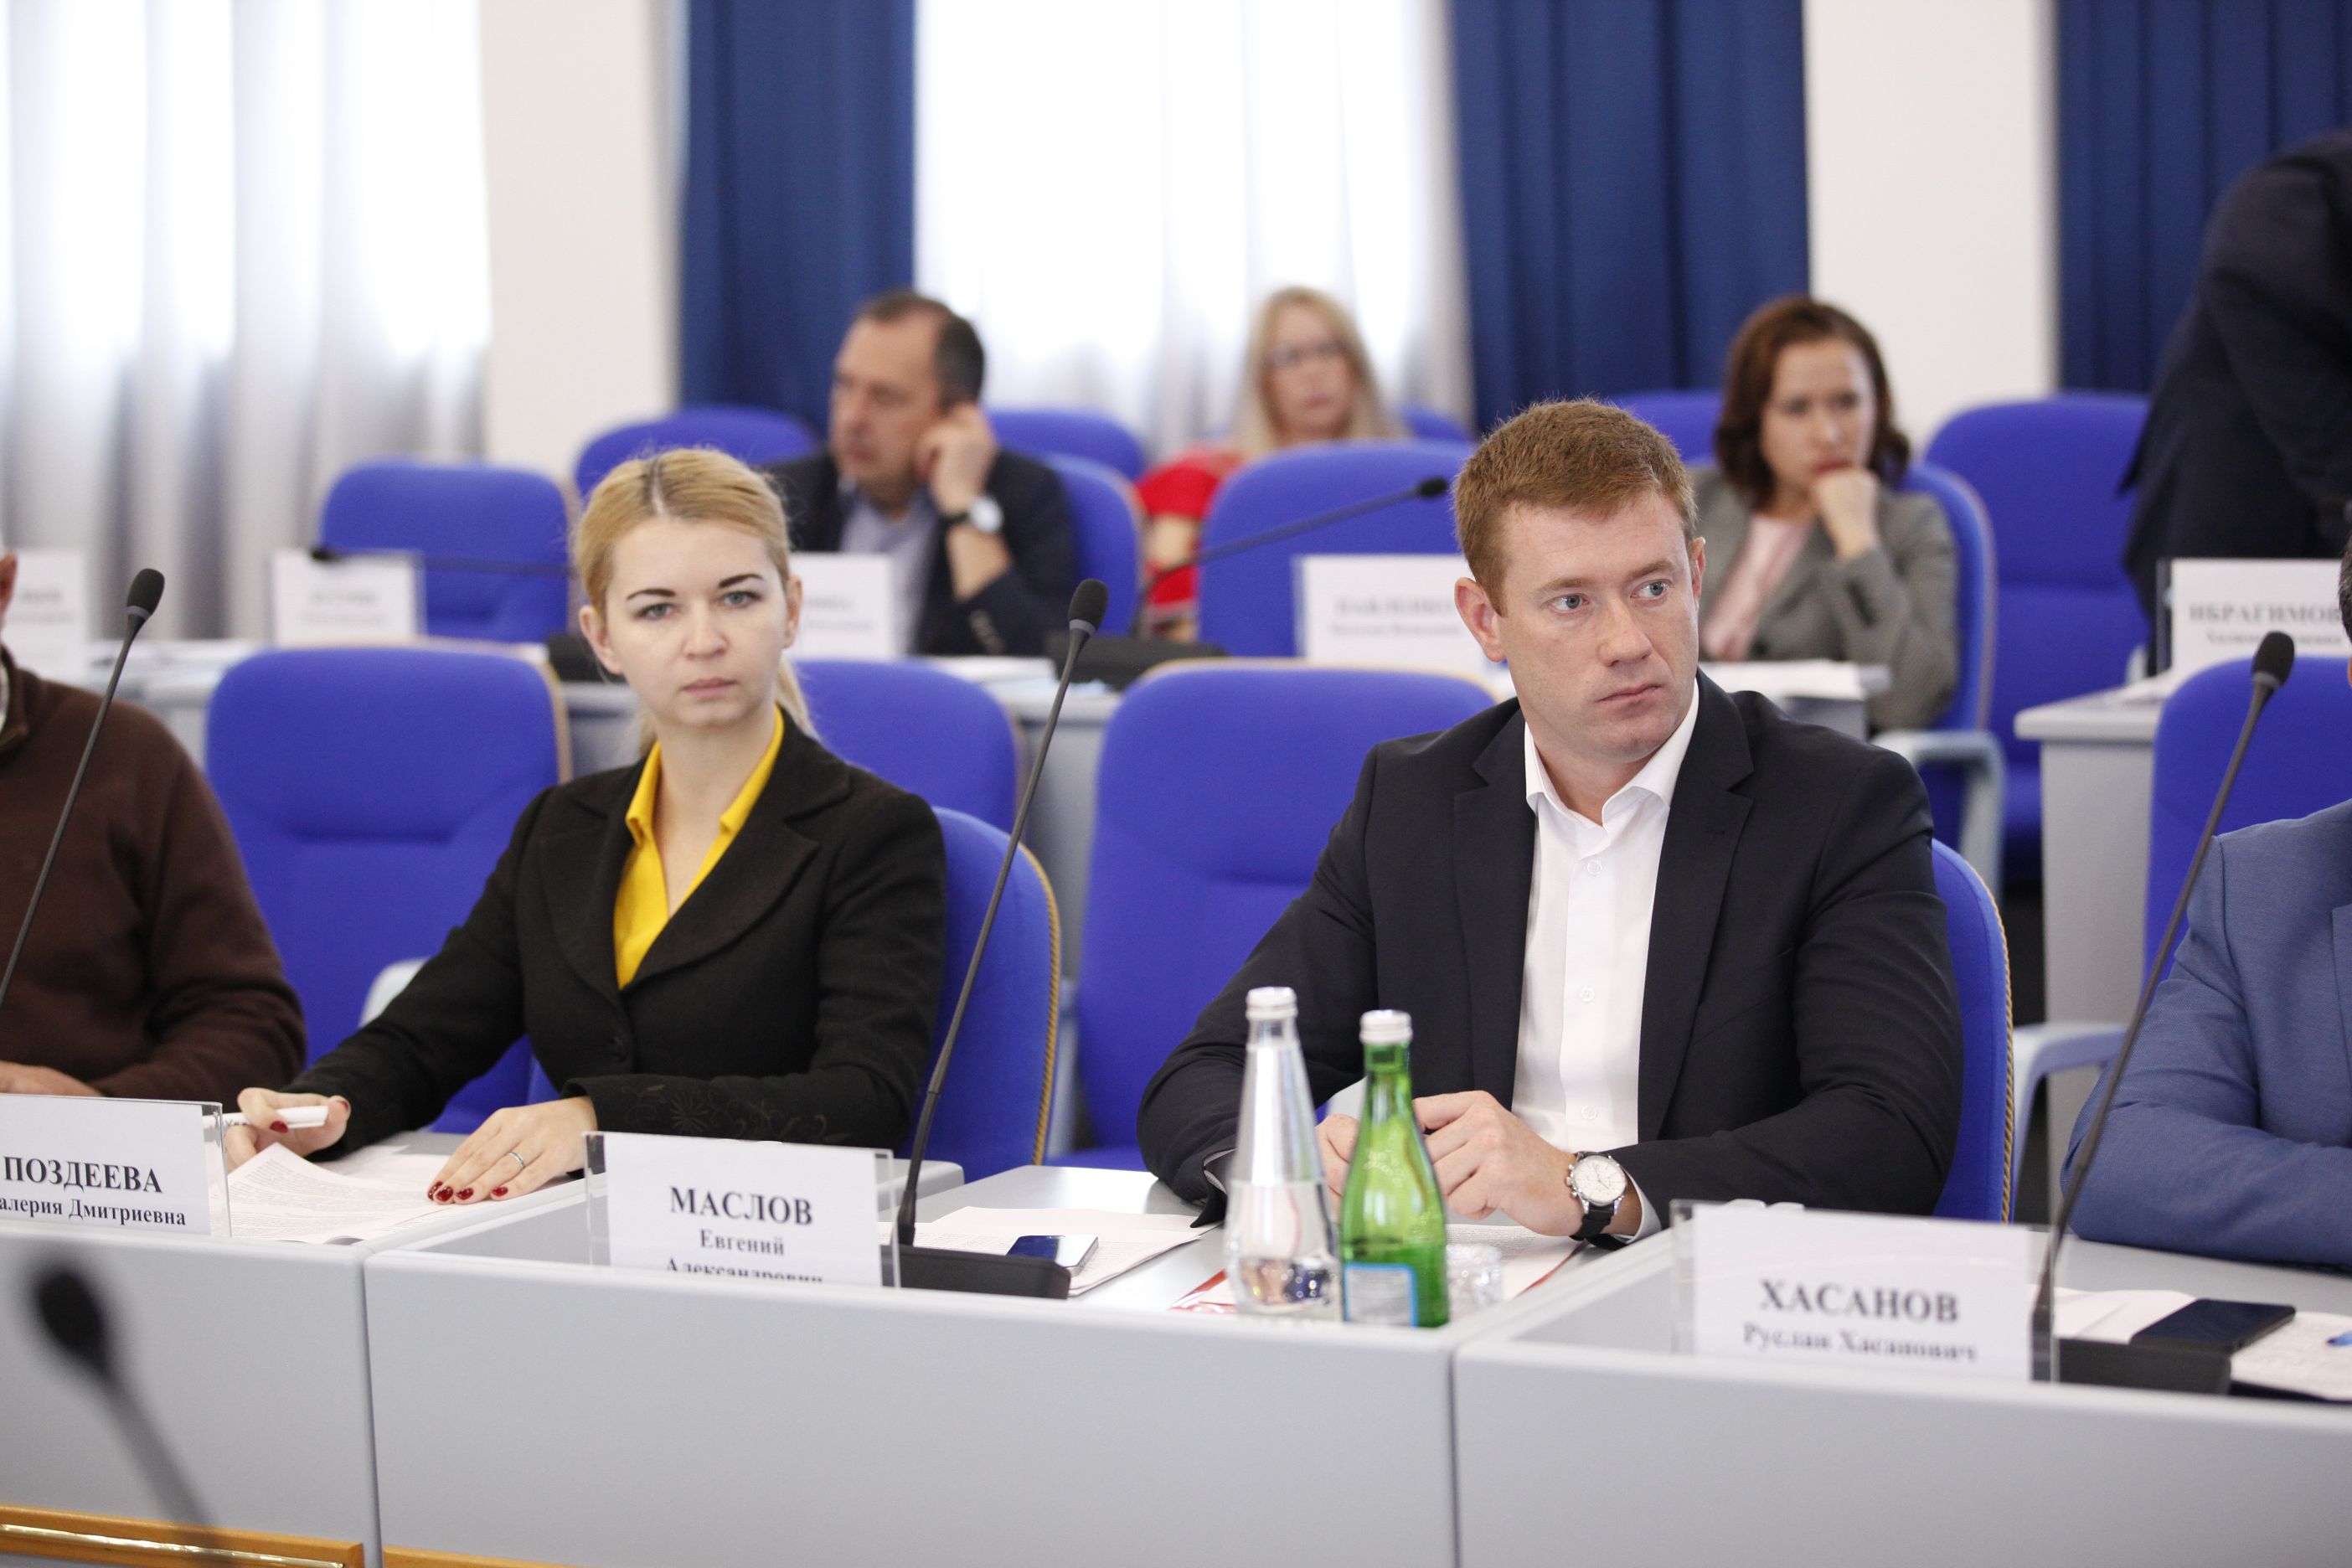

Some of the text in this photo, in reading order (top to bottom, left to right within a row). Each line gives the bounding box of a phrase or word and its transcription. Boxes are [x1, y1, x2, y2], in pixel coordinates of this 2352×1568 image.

[3, 1156, 163, 1193] ПОЗДЕЕВА
[0, 1197, 187, 1225] алерия Дмитриевна
[670, 1186, 813, 1226] МАСЛОВ
[699, 1229, 785, 1256] Евгений
[1761, 1278, 1959, 1323] ХАСАНОВ
[1743, 1322, 1978, 1363] Руслан Хасанович
